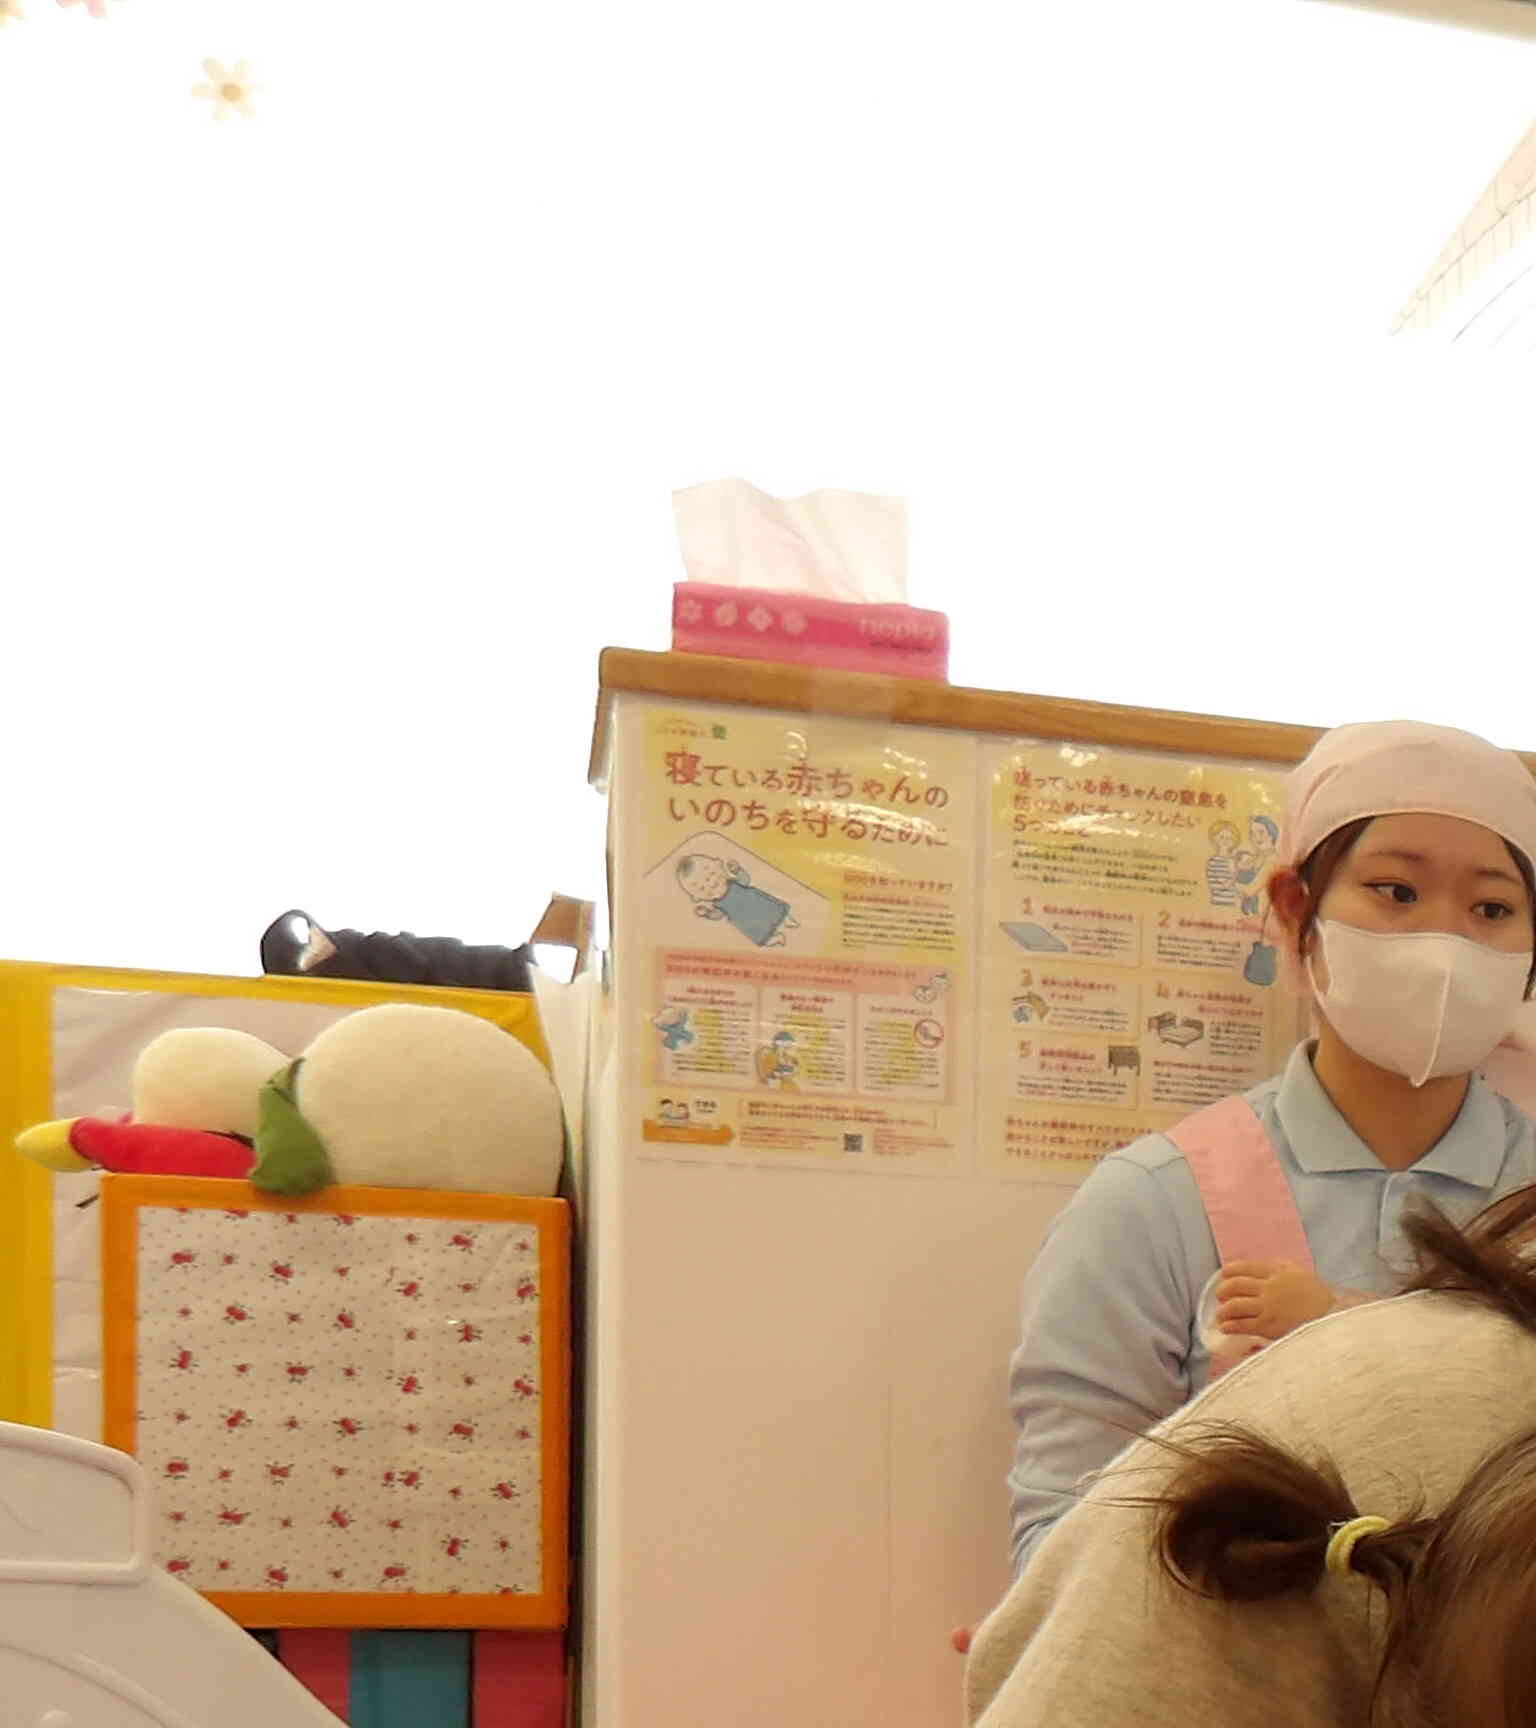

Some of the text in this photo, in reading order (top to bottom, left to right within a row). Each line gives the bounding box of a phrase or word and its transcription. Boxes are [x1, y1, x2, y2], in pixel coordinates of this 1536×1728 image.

[664, 748, 949, 808] 寝ている赤ちゃんの
[668, 797, 949, 847] いのちを守るために
